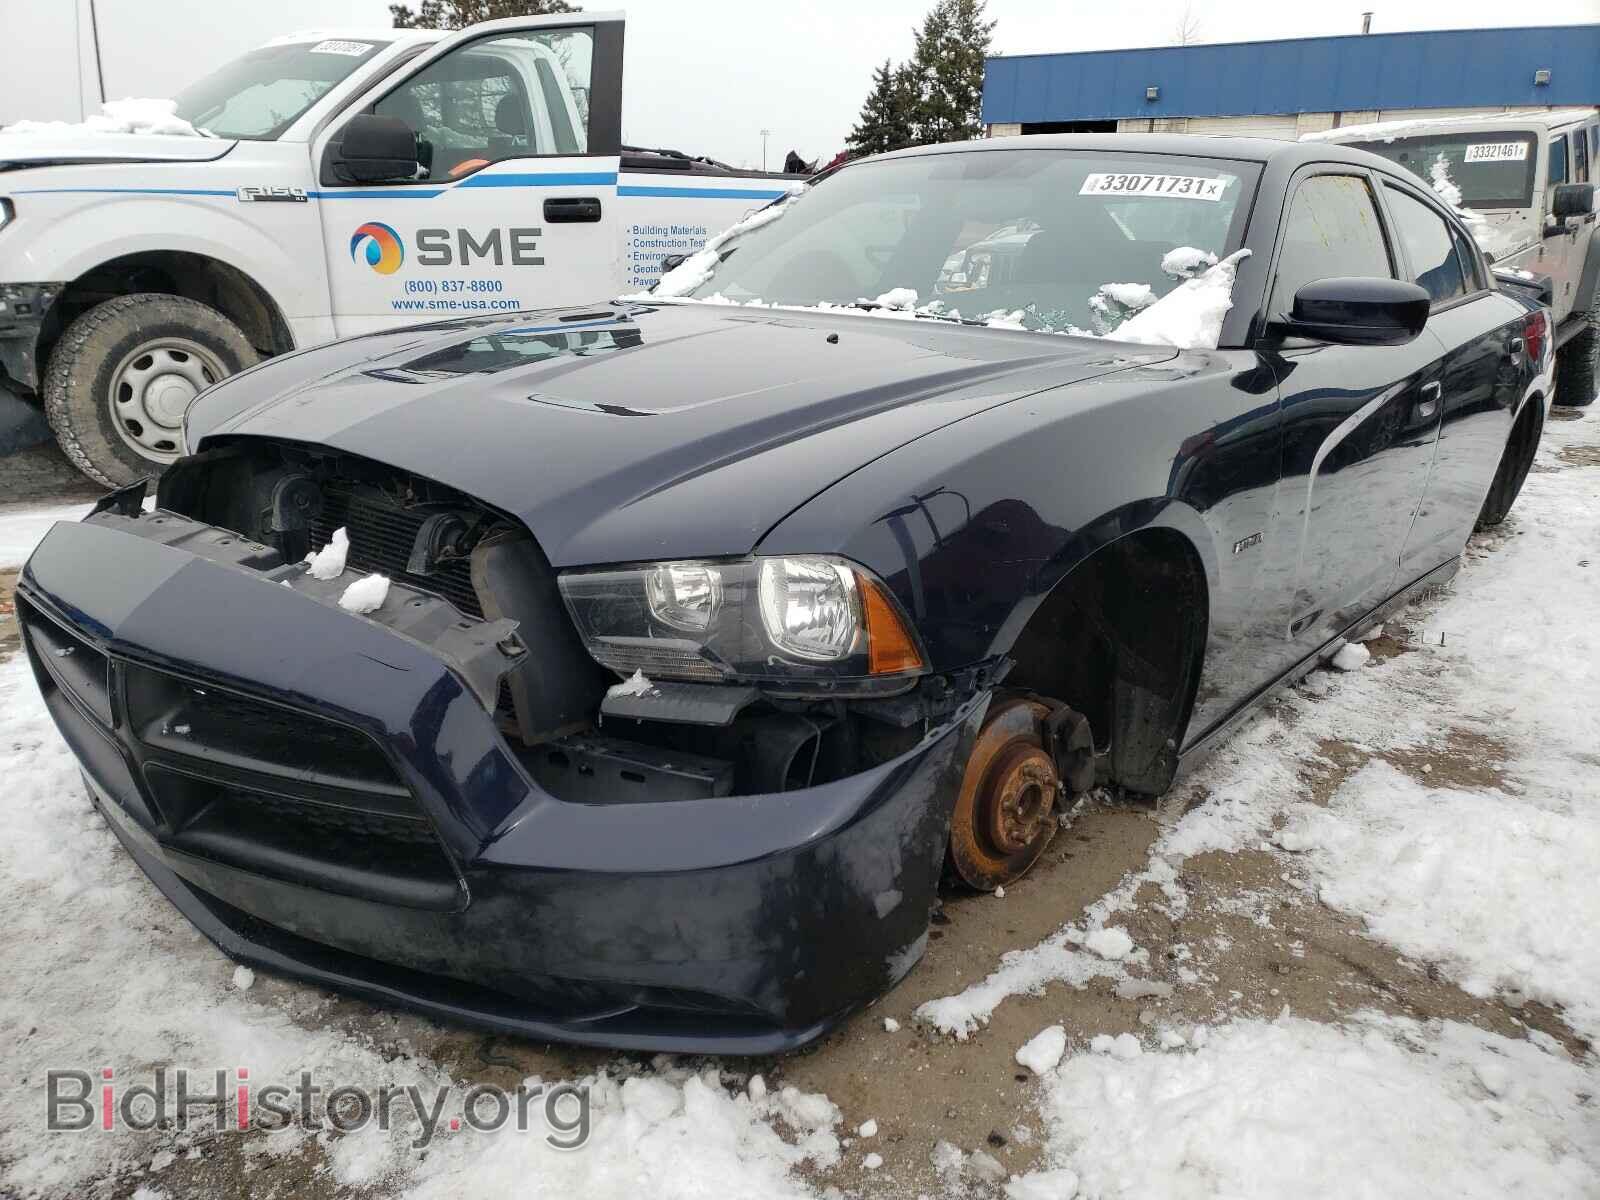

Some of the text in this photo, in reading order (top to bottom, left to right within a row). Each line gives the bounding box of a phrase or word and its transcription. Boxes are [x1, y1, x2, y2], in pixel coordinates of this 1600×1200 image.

[1473, 144, 1519, 158] 33321461
[1100, 174, 1204, 195] 33071731
[632, 225, 707, 237] Building Materials
[416, 228, 545, 265] SME
[633, 238, 708, 248] Construction Test
[404, 280, 503, 295] (800) 837-8800
[391, 299, 520, 309] www.sme-usa.com
